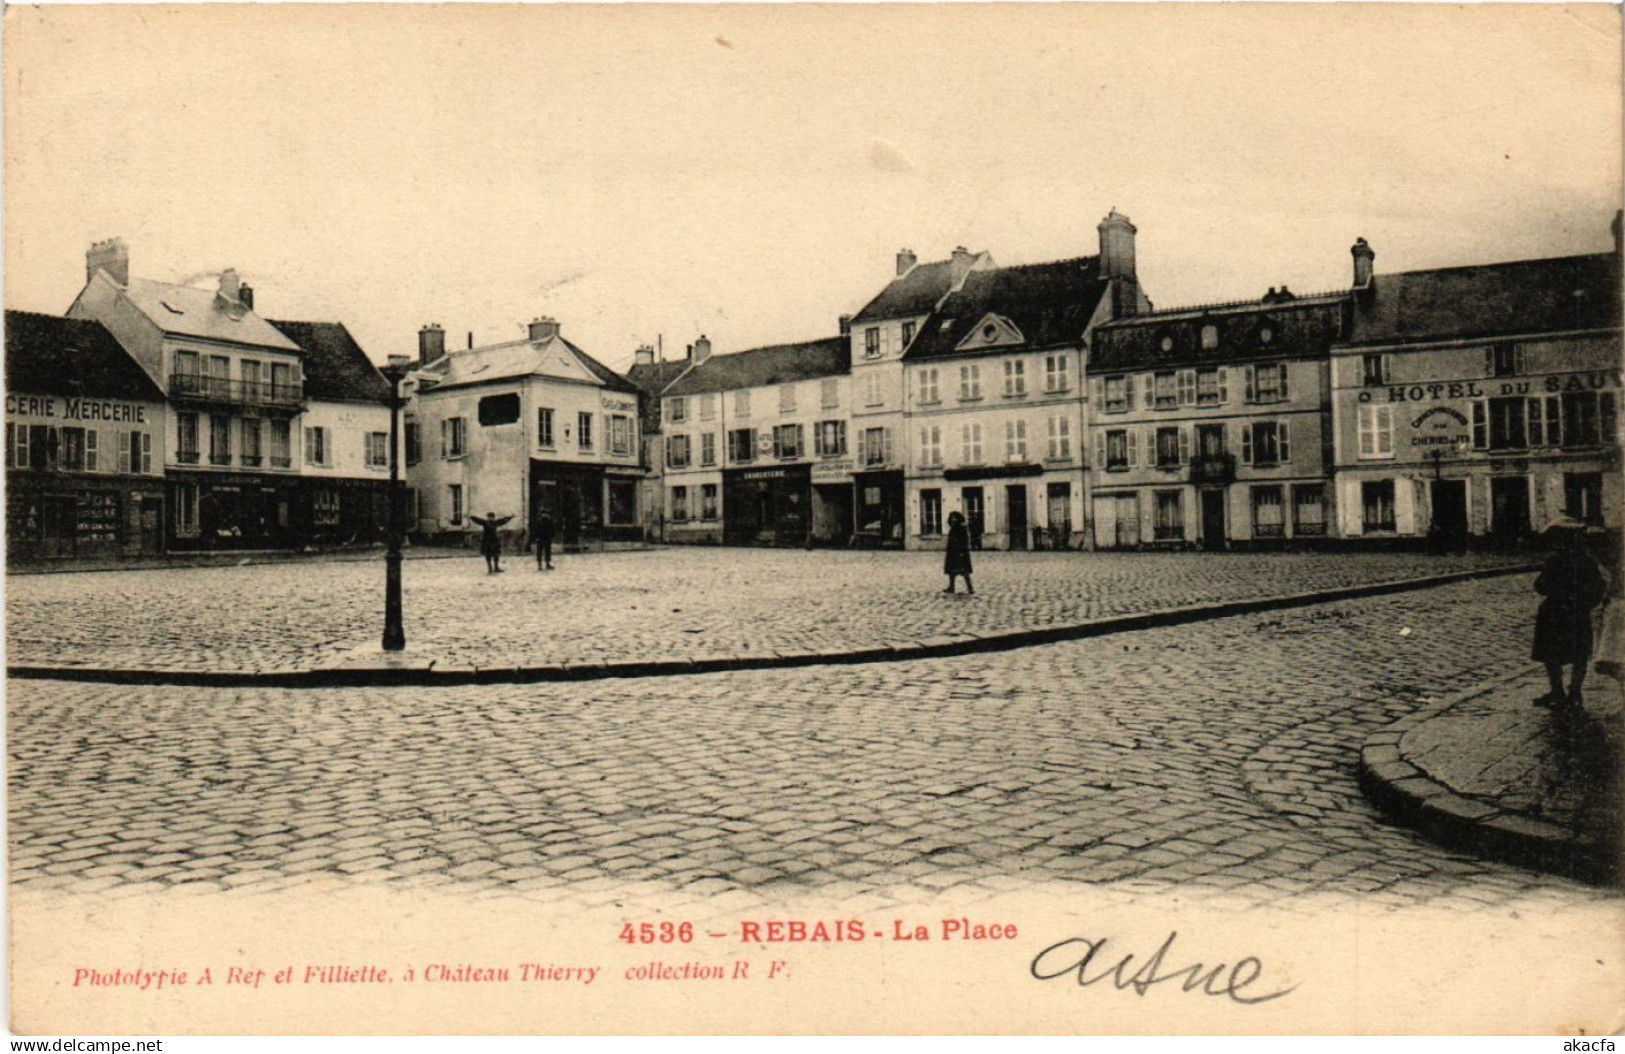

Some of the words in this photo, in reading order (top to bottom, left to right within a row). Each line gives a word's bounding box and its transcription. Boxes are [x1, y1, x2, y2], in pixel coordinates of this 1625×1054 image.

[1388, 382, 1483, 402] HOTEL
[1502, 382, 1529, 395] DU
[62, 398, 146, 423] MERCERIE
